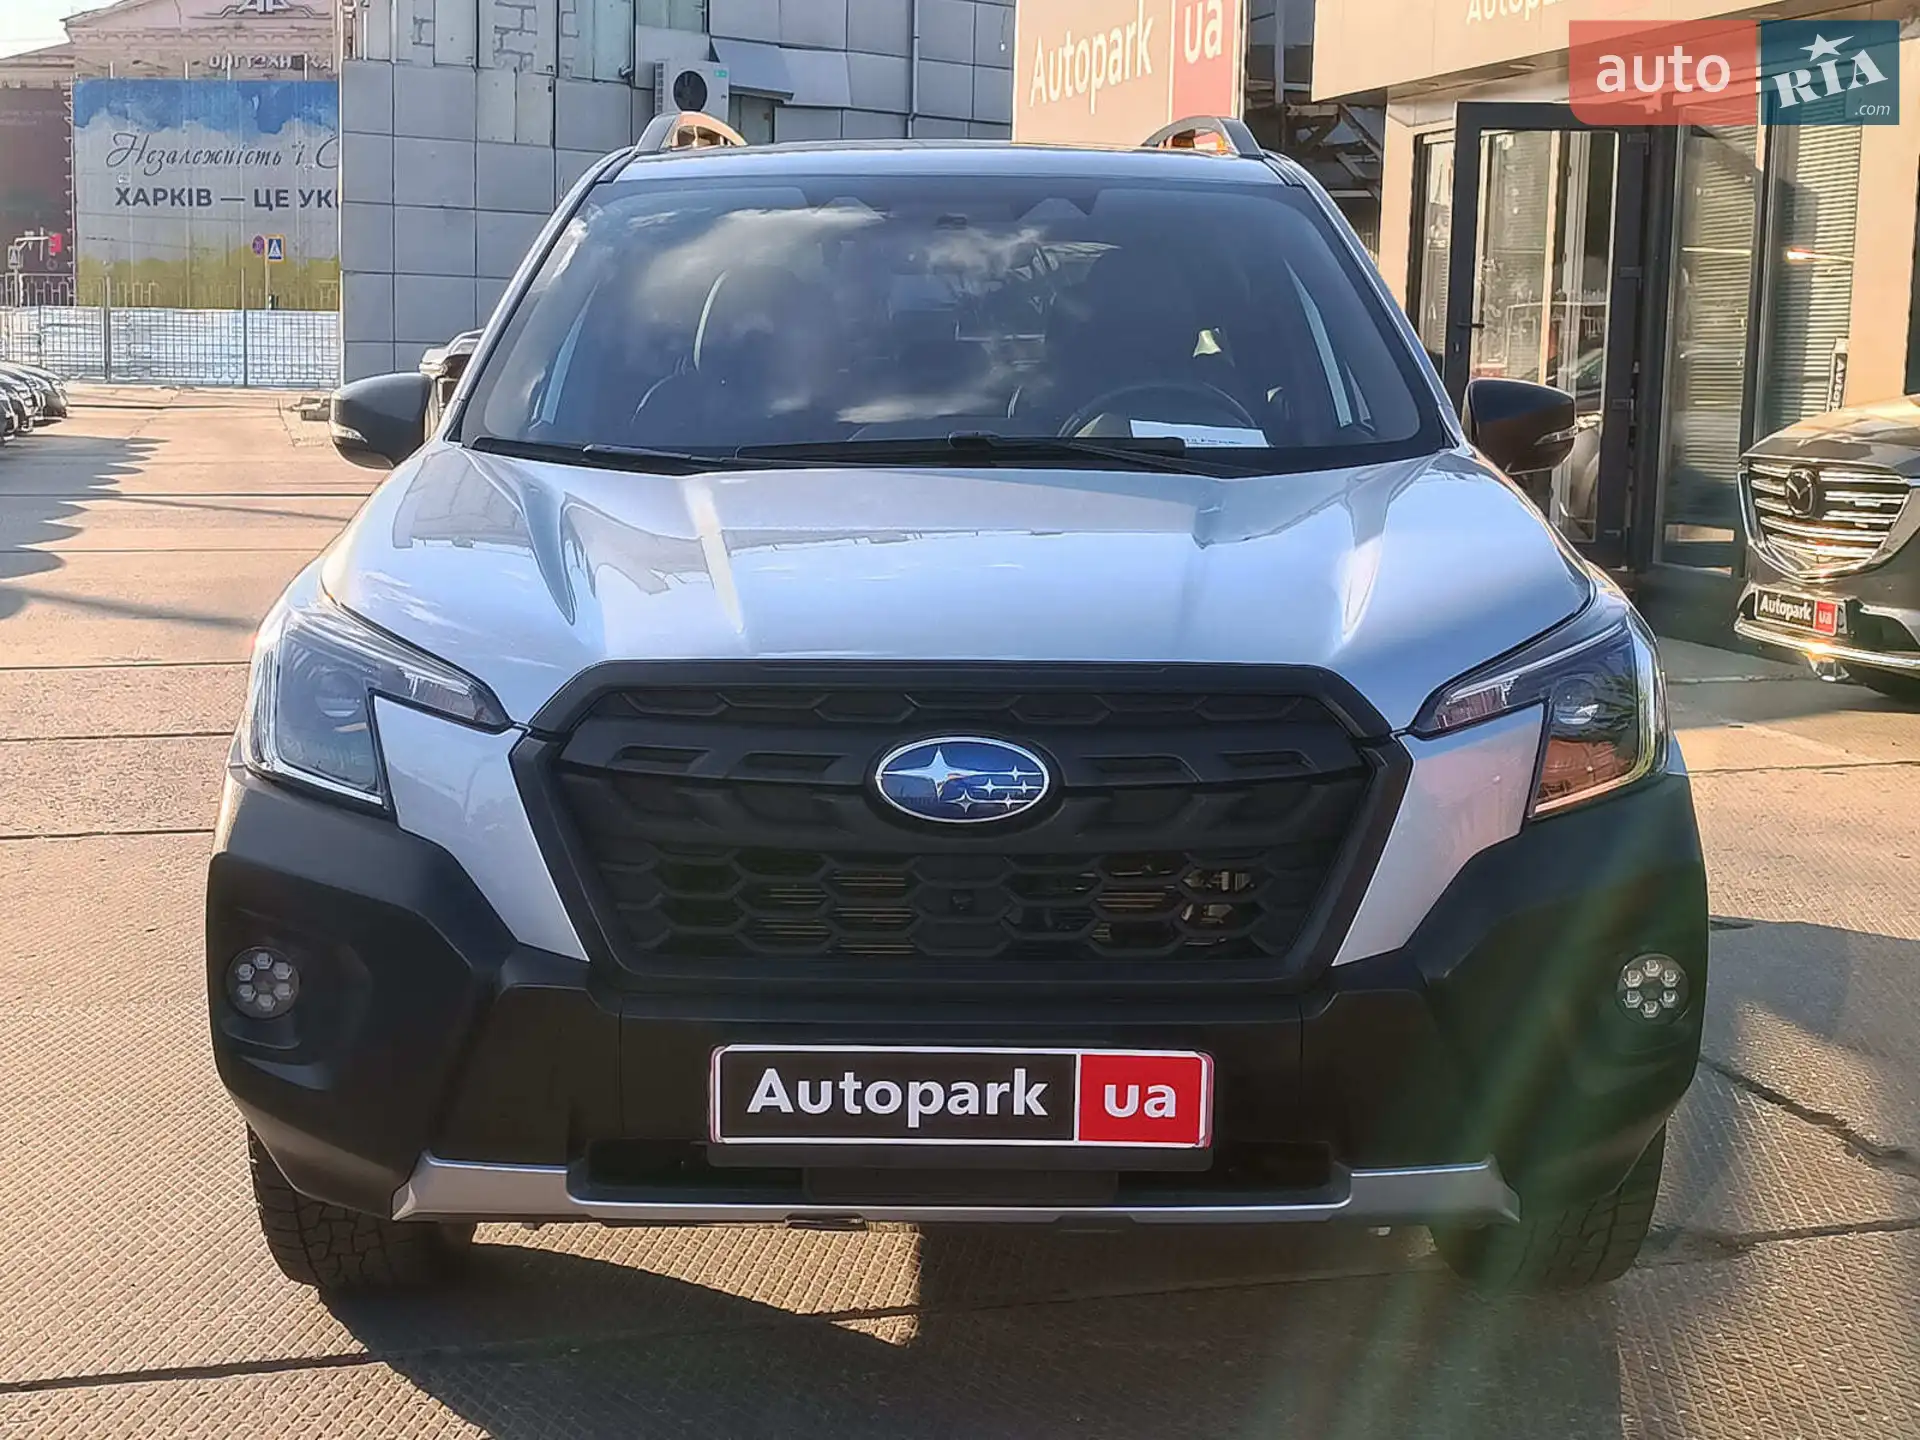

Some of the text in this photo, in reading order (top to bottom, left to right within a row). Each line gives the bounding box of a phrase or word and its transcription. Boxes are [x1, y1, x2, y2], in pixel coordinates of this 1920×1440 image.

[1029, 0, 1223, 115] Autopark ua
[106, 132, 282, 176] Незалежність
[115, 187, 212, 207] ХАРКІВ
[253, 188, 289, 210] ЦЕ
[1760, 594, 1833, 625] Autopark ua
[747, 1067, 1177, 1128] Autopark ua
